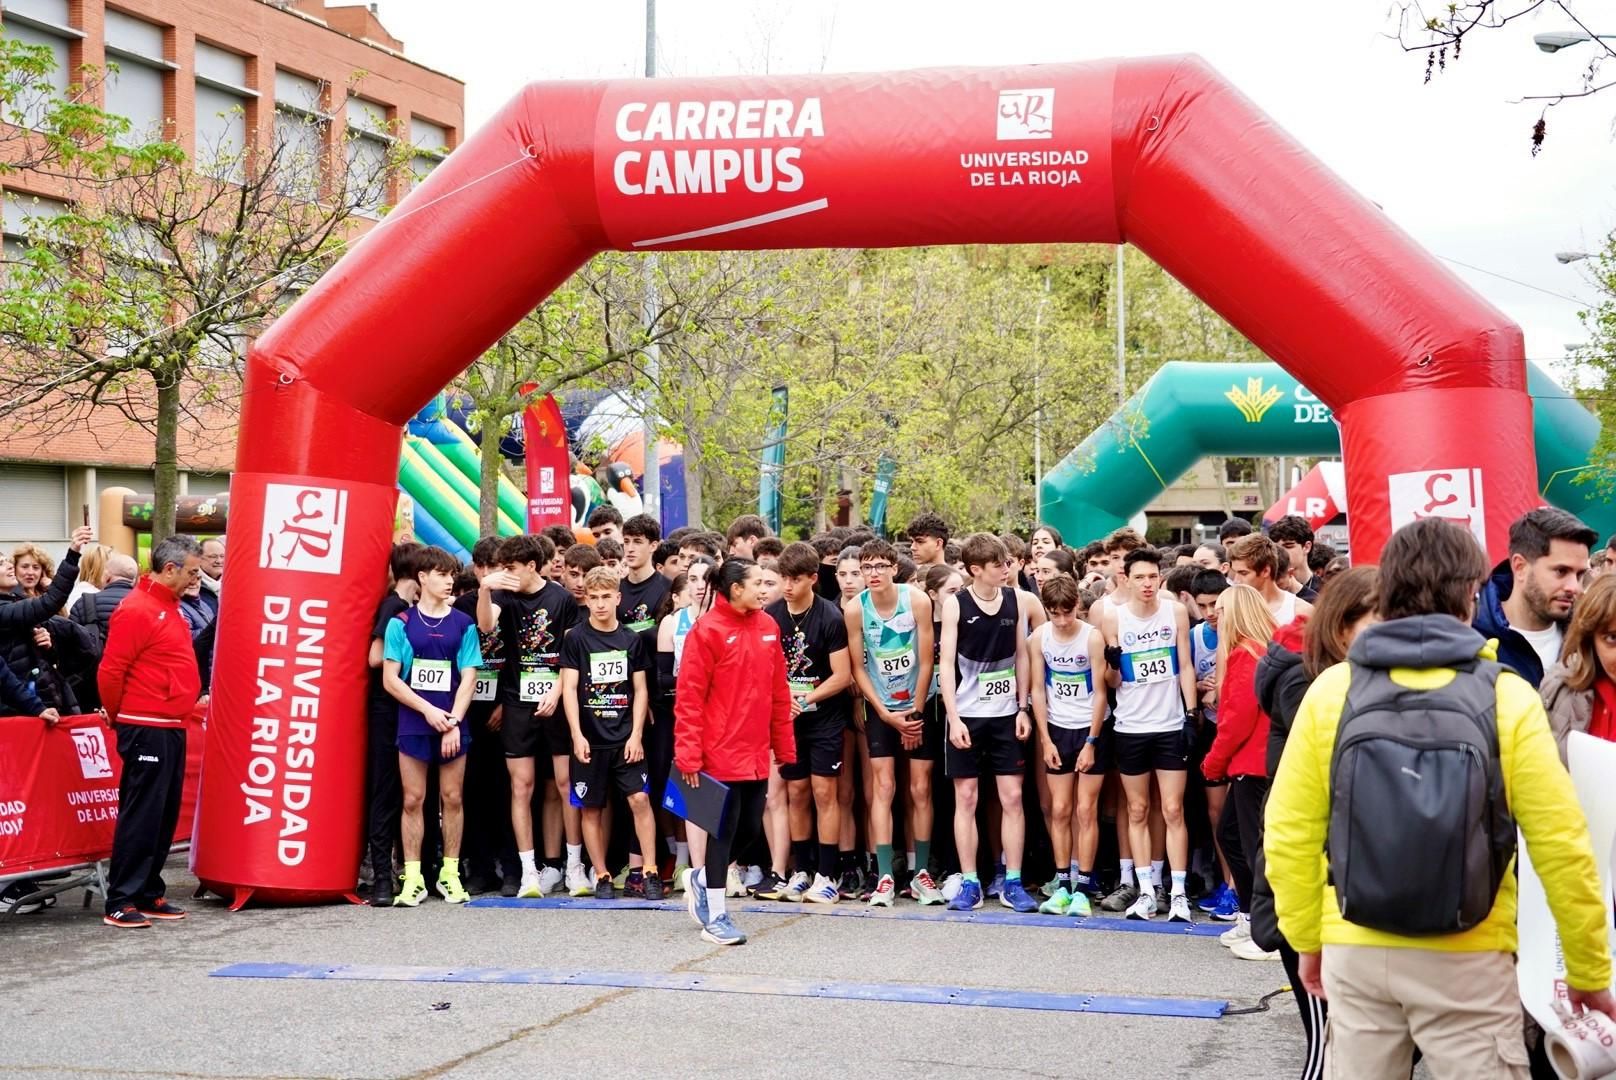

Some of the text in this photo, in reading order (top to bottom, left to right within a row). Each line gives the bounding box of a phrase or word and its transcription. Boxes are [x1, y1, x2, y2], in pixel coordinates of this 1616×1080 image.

[615, 97, 825, 142] CARRERA
[960, 150, 1089, 168] UNIVERSIDAD
[613, 146, 804, 196] CAMPUS
[971, 169, 1081, 188] DE LA RIOJA
[598, 661, 623, 677] 375
[883, 655, 911, 672] 876
[1140, 660, 1167, 678] 343
[418, 669, 444, 684] 607
[985, 680, 1010, 696] 288
[1055, 682, 1080, 697] 337
[240, 595, 291, 825] DE LA RIOJA
[278, 600, 328, 867] UNIVERSIDAD
[77, 809, 94, 823] DE
[94, 808, 108, 821] LA
